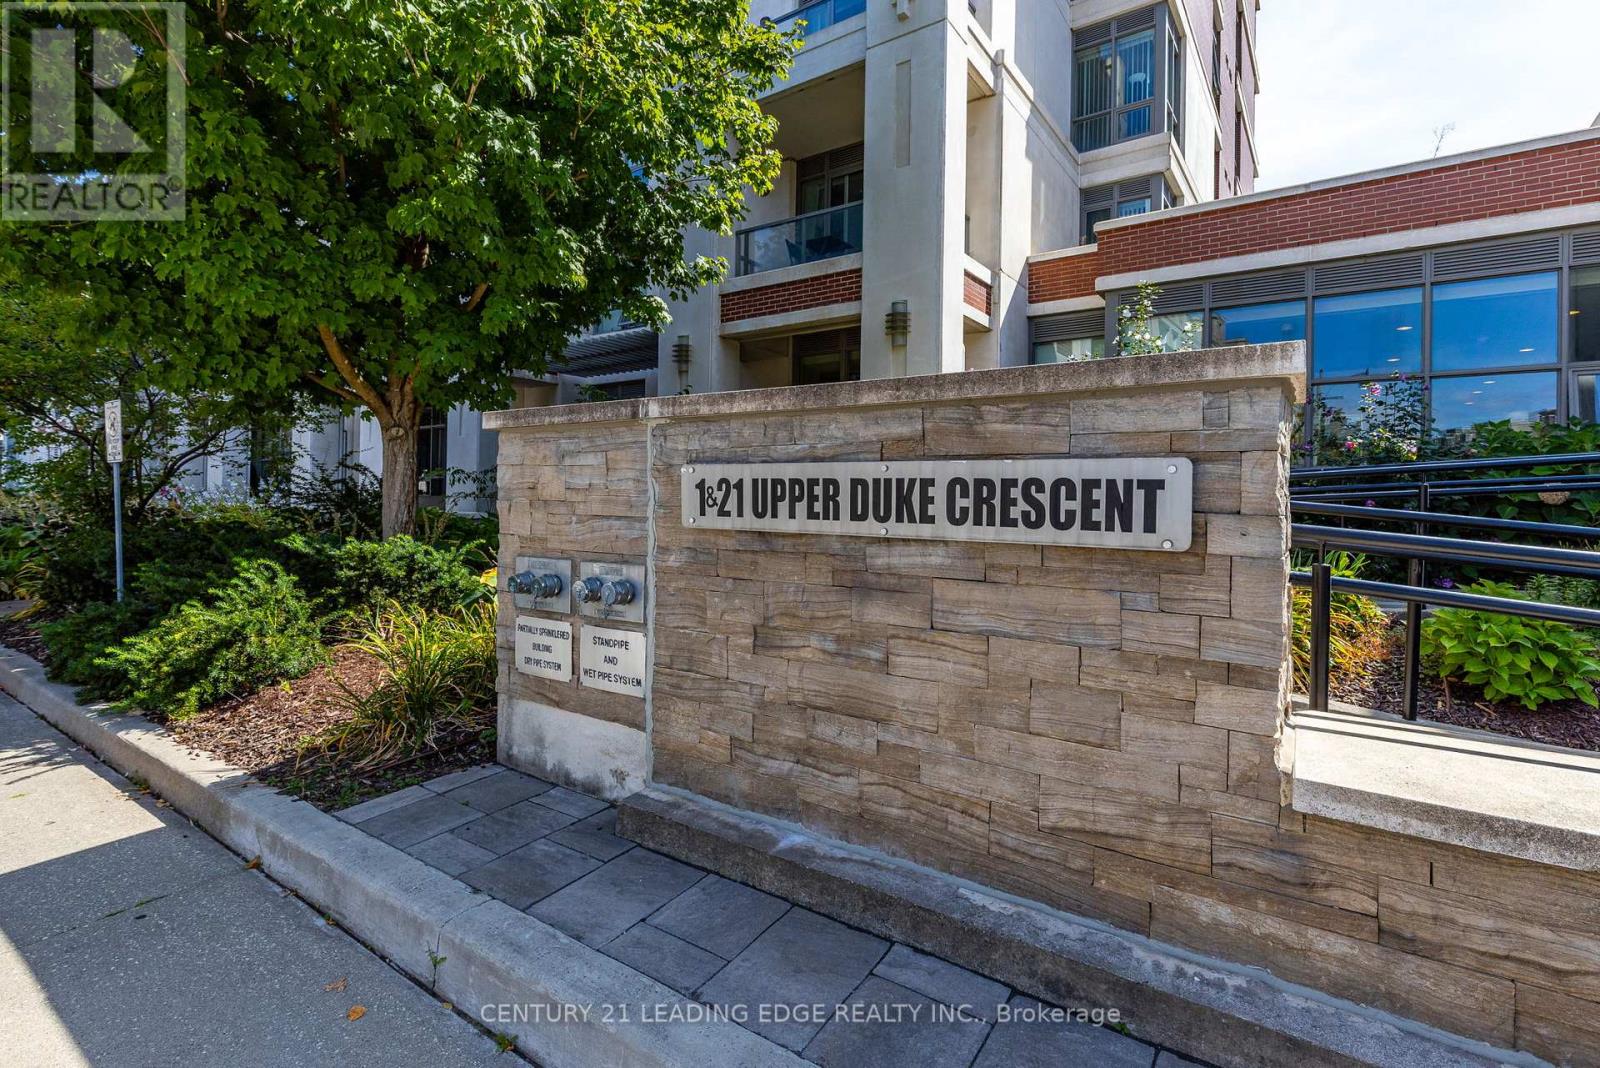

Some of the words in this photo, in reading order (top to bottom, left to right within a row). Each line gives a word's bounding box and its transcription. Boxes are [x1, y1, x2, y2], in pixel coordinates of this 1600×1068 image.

[695, 477, 744, 518] 1&21
[751, 477, 840, 521] UPPER
[849, 477, 936, 525] DUKE
[946, 476, 1166, 534] CRESCENT
[517, 623, 539, 635] PARTIALLY
[538, 627, 570, 640] SPRINKLERED
[532, 642, 553, 654] BUILDING
[592, 635, 630, 651] STANDPIPE
[533, 659, 543, 668] PIPE
[543, 660, 562, 672] SYSTEM
[603, 655, 618, 666] AND
[583, 667, 597, 679] WET
[597, 670, 613, 683] PIPE
[613, 673, 642, 687] SYSTEM
